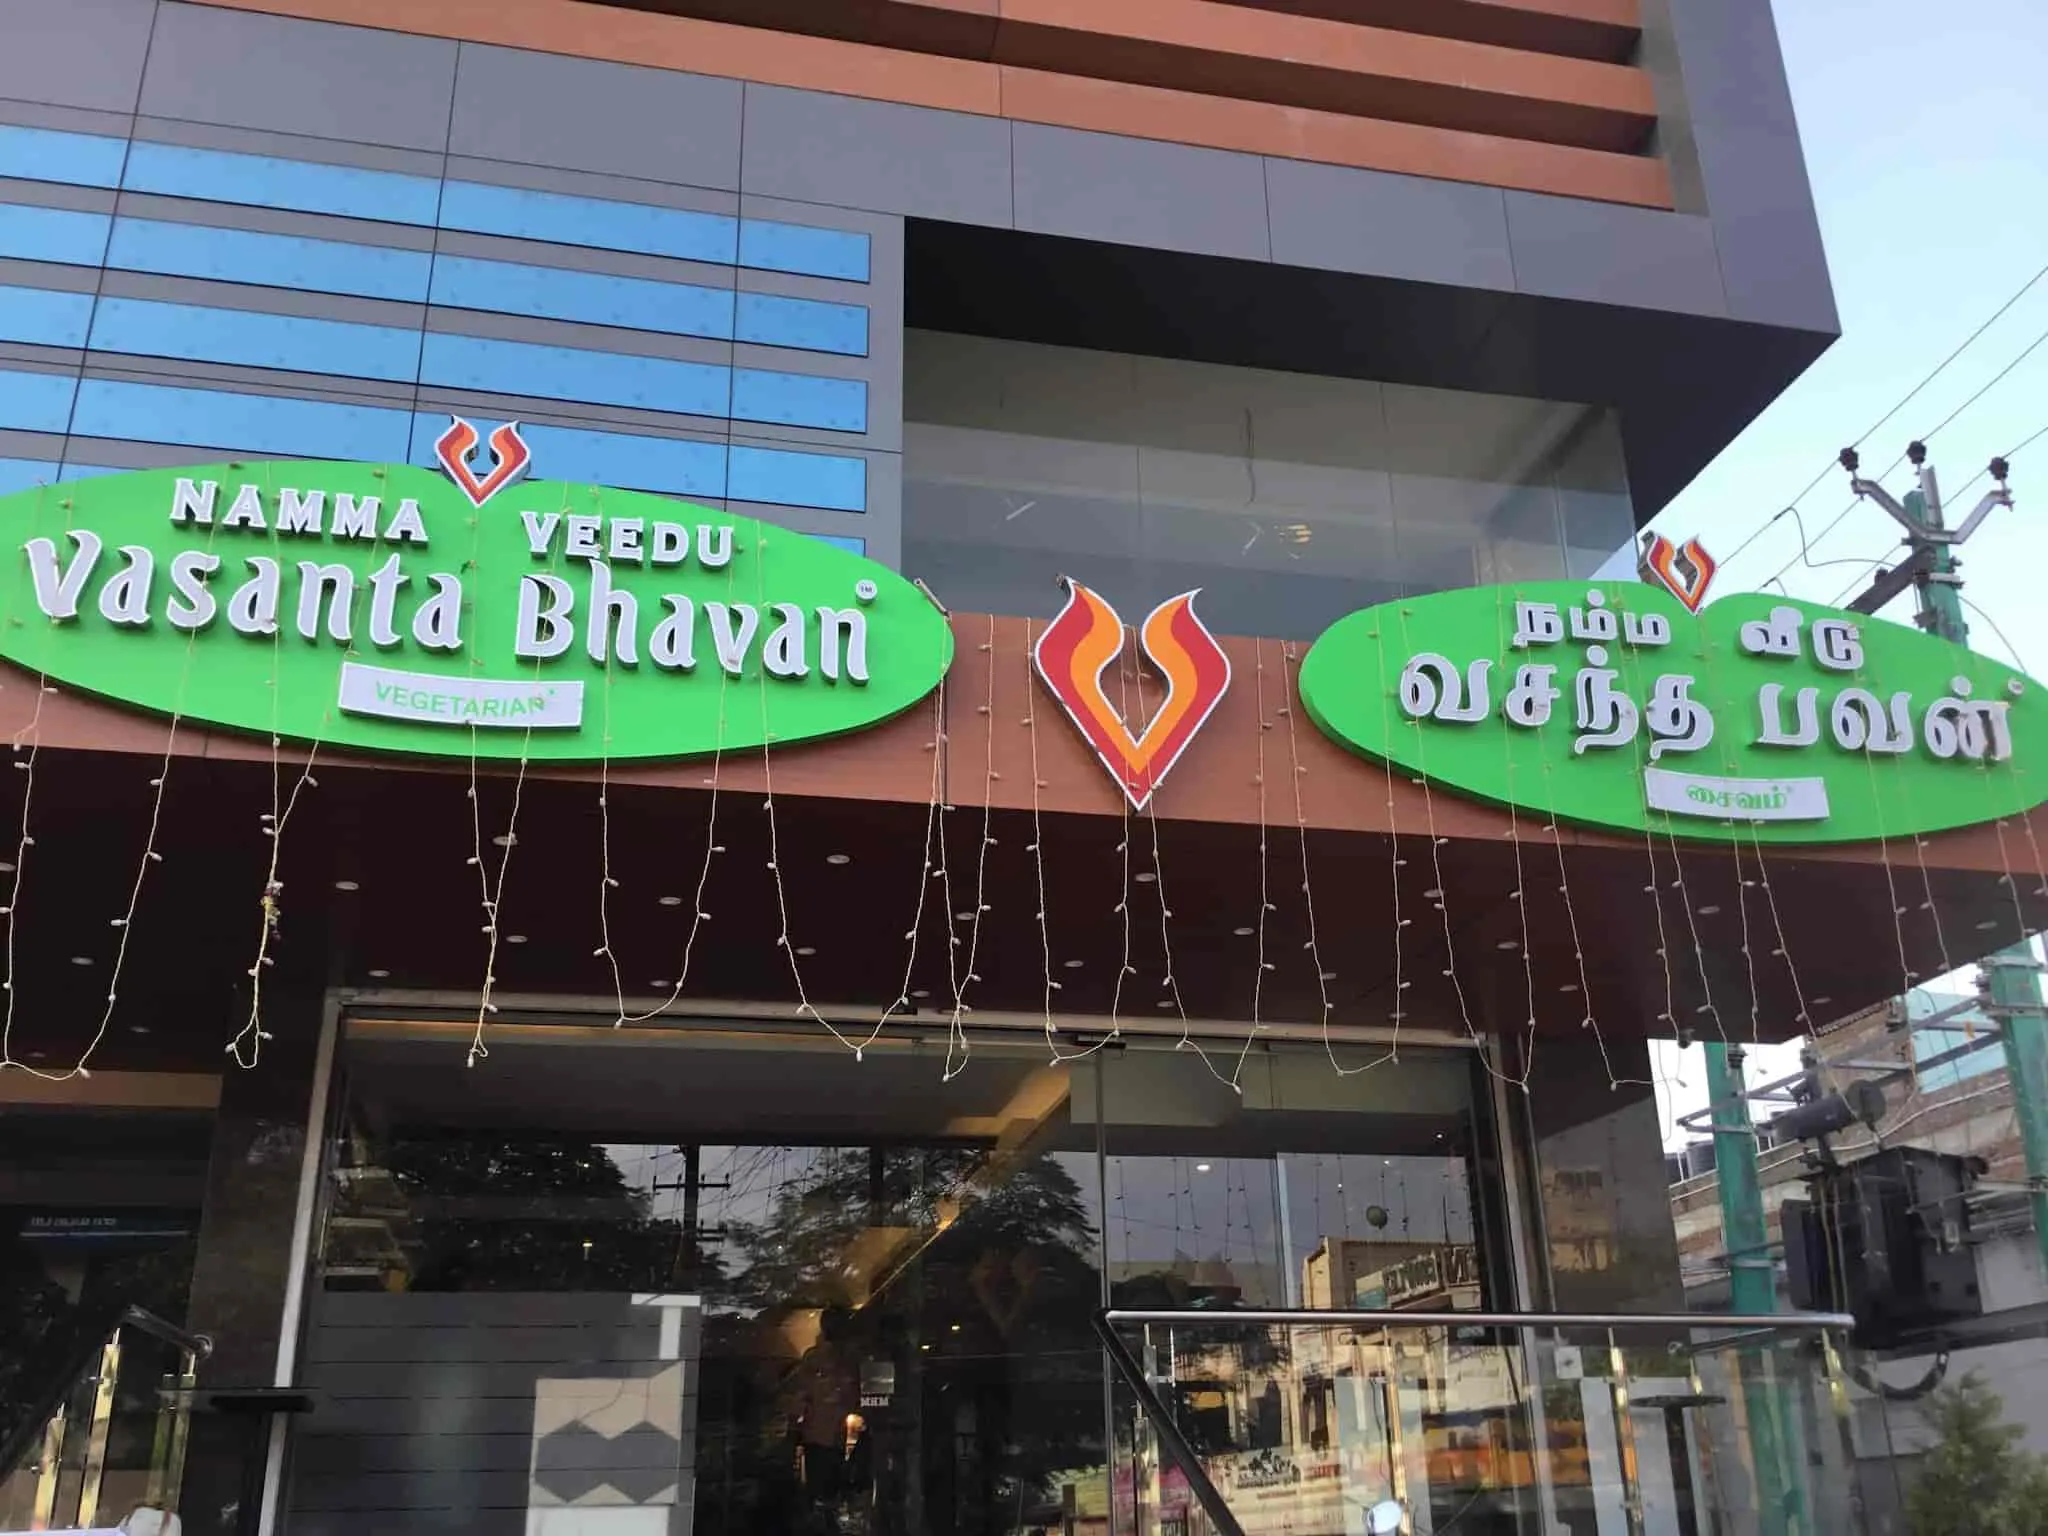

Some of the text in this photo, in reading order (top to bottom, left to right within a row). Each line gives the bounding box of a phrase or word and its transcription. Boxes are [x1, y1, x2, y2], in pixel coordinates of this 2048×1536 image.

[171, 478, 735, 568] NAMMA VEEDU
[24, 529, 464, 652] Vasanta
[515, 557, 869, 685] Bhavan
[1512, 588, 1864, 670] நம்ம வீடு
[375, 681, 546, 718] VEGETARIAN
[1400, 645, 2013, 761] வசந்த பவன்
